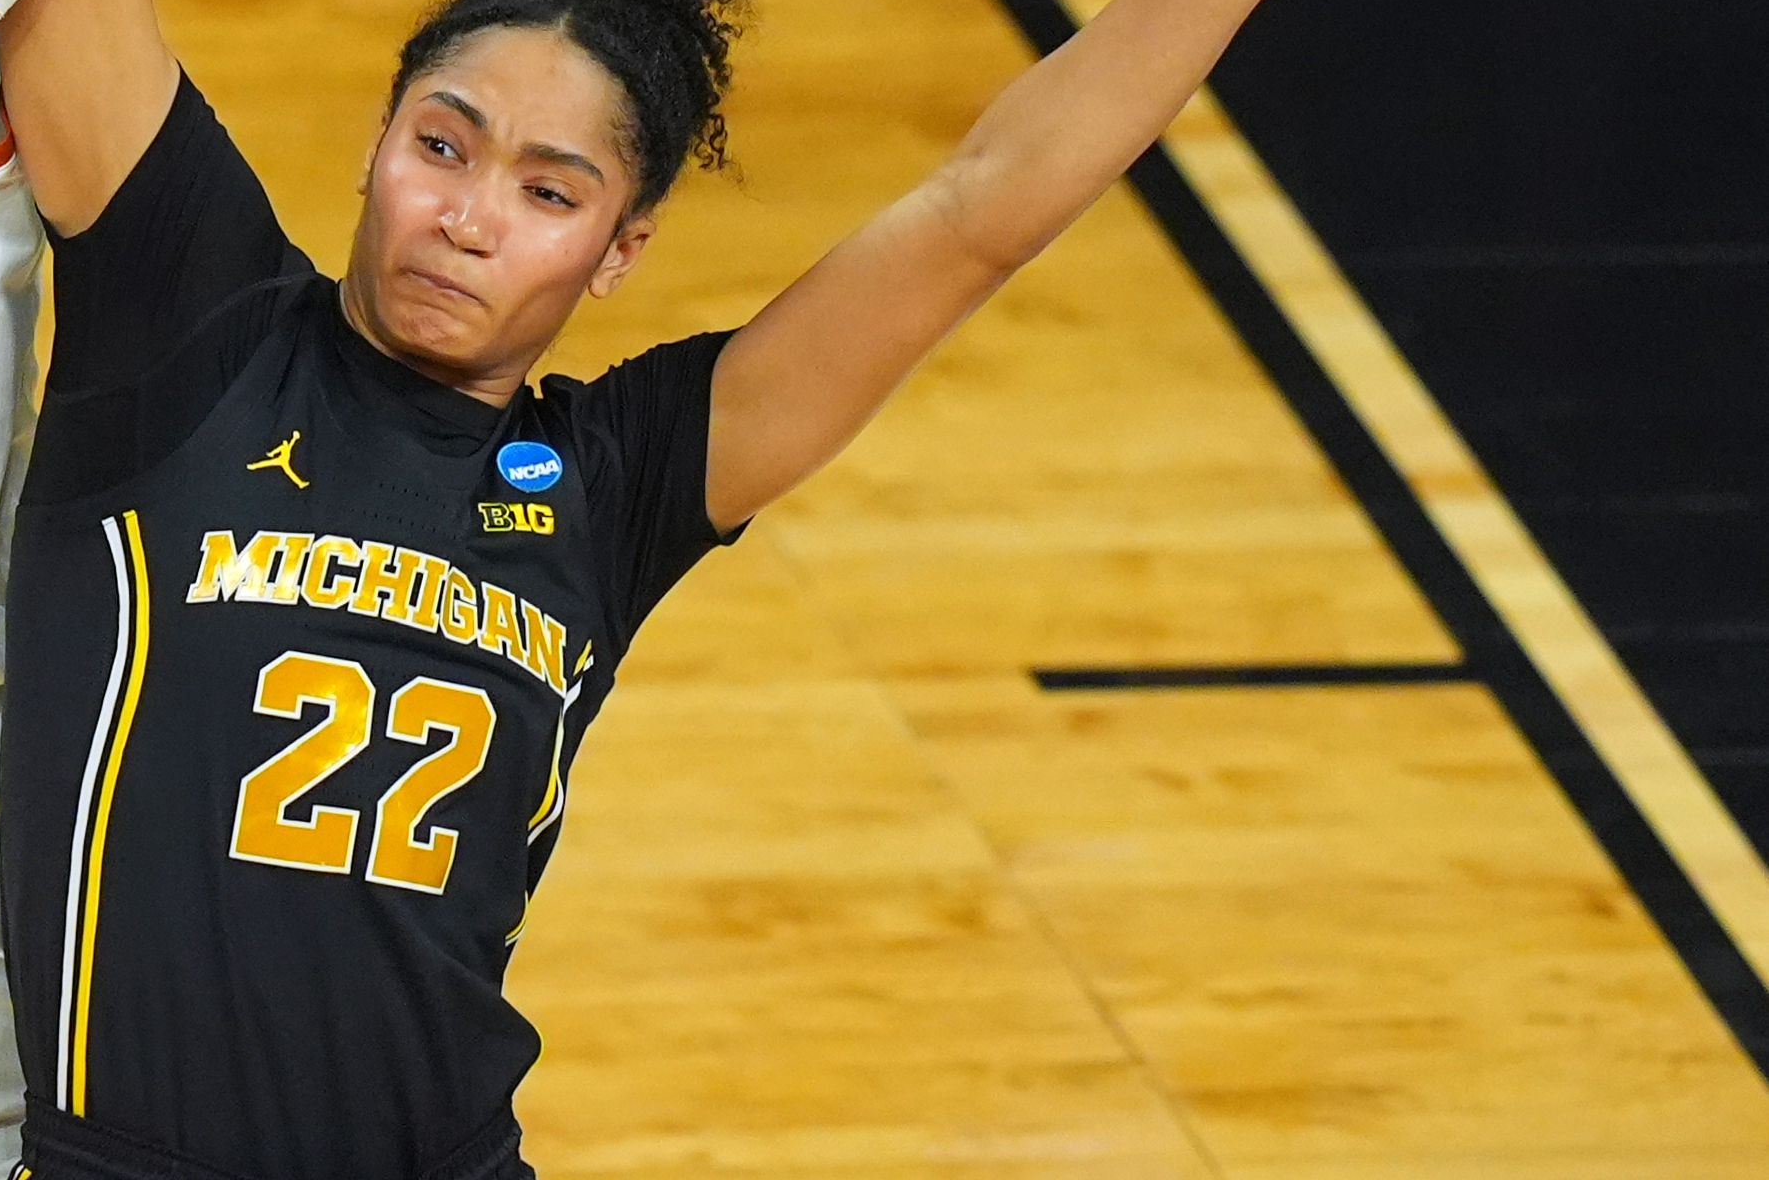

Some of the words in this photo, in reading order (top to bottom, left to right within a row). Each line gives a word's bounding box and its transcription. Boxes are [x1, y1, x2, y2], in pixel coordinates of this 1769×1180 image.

[507, 458, 561, 481] NCAA
[185, 529, 568, 699] MICHIGAN
[228, 650, 498, 897] 22
